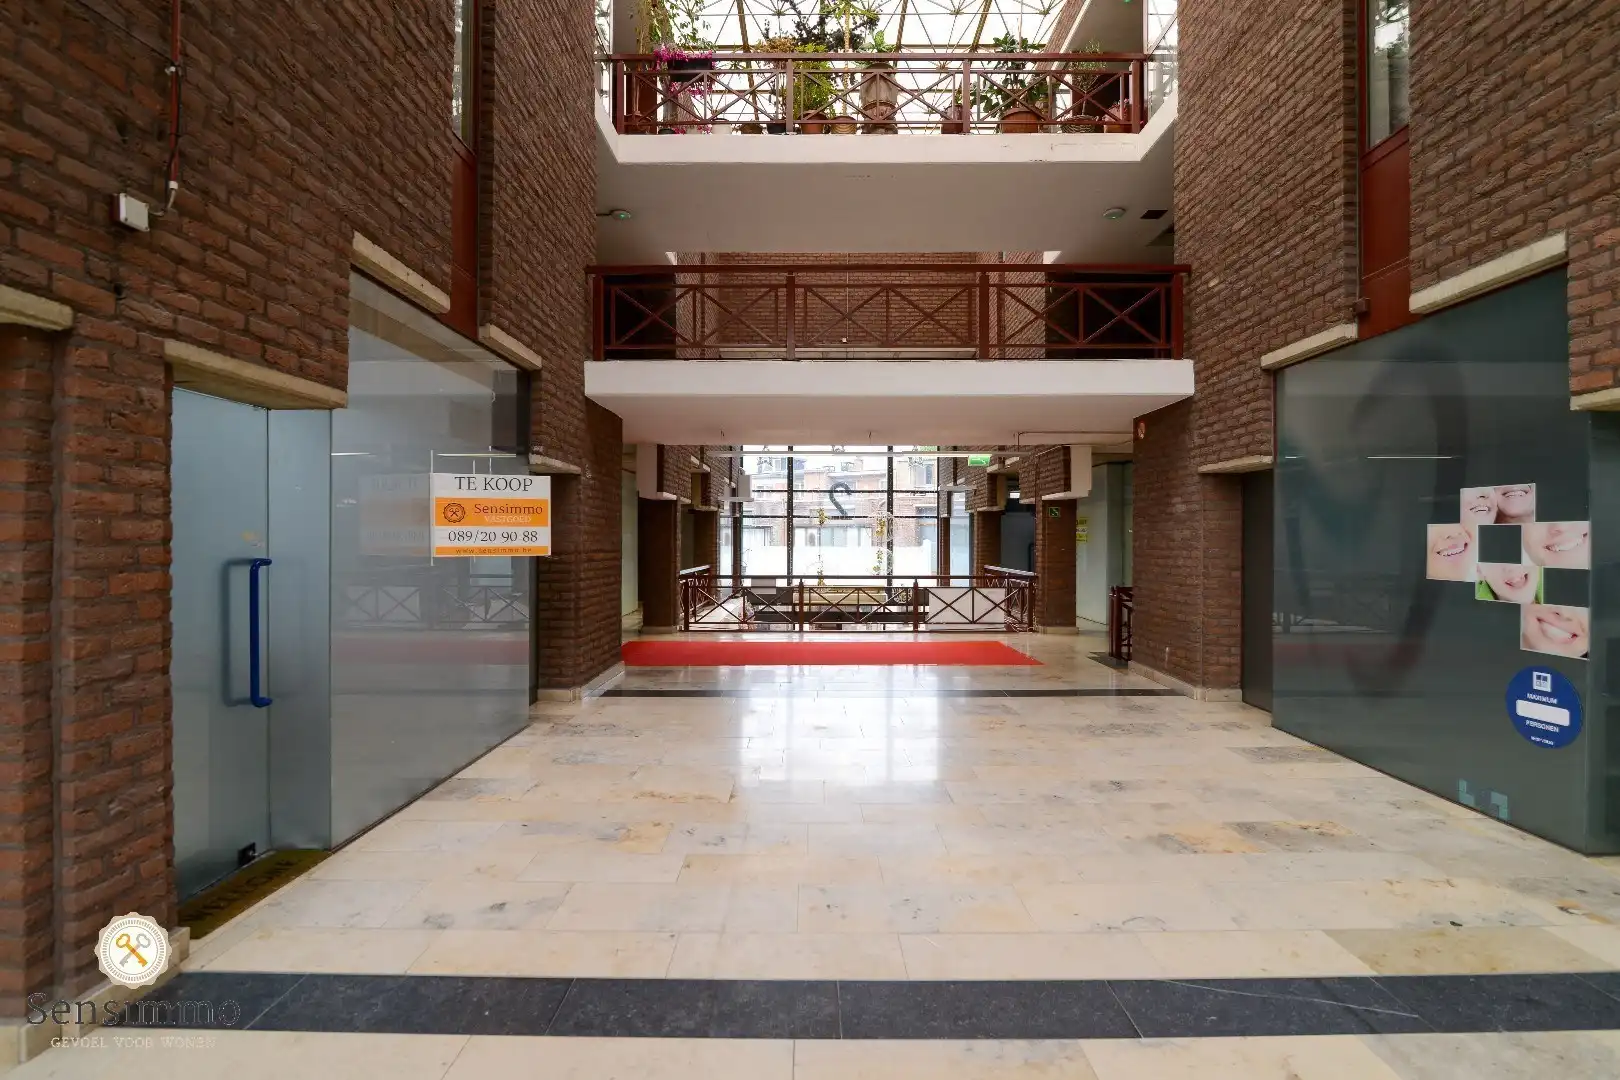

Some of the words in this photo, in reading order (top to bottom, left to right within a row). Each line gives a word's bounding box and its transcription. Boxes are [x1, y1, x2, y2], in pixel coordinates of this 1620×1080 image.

[455, 476, 477, 491] TE
[484, 477, 533, 492] KOOP
[474, 503, 543, 515] Sensimmo
[484, 515, 532, 523] VASTGOED
[448, 530, 497, 544] 089/20
[502, 531, 518, 543] 90
[522, 531, 538, 542] 88
[1527, 693, 1558, 704] MAXIMUM
[1526, 720, 1559, 732] PERSONEN
